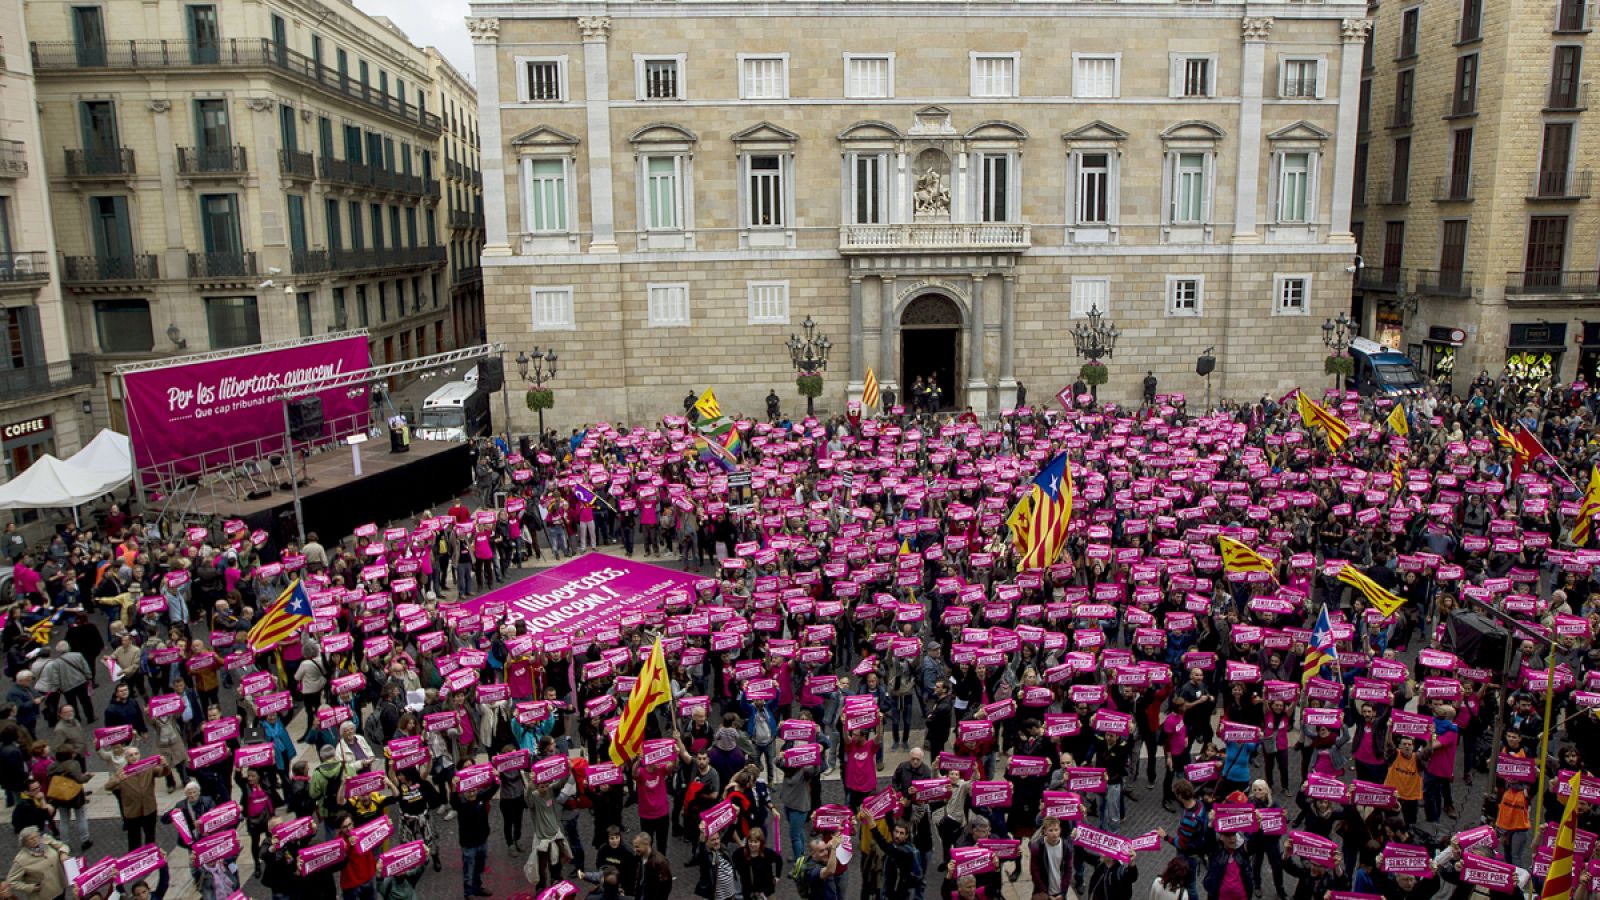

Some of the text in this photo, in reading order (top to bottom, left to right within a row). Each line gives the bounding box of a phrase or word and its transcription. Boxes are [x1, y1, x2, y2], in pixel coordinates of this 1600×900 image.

[168, 387, 193, 411] Per
[197, 382, 215, 404] les
[195, 408, 213, 418] Que
[214, 403, 230, 414] cap
[232, 396, 265, 410] tribunal
[5, 419, 44, 437] COFFEE
[513, 567, 630, 612] llibertats,
